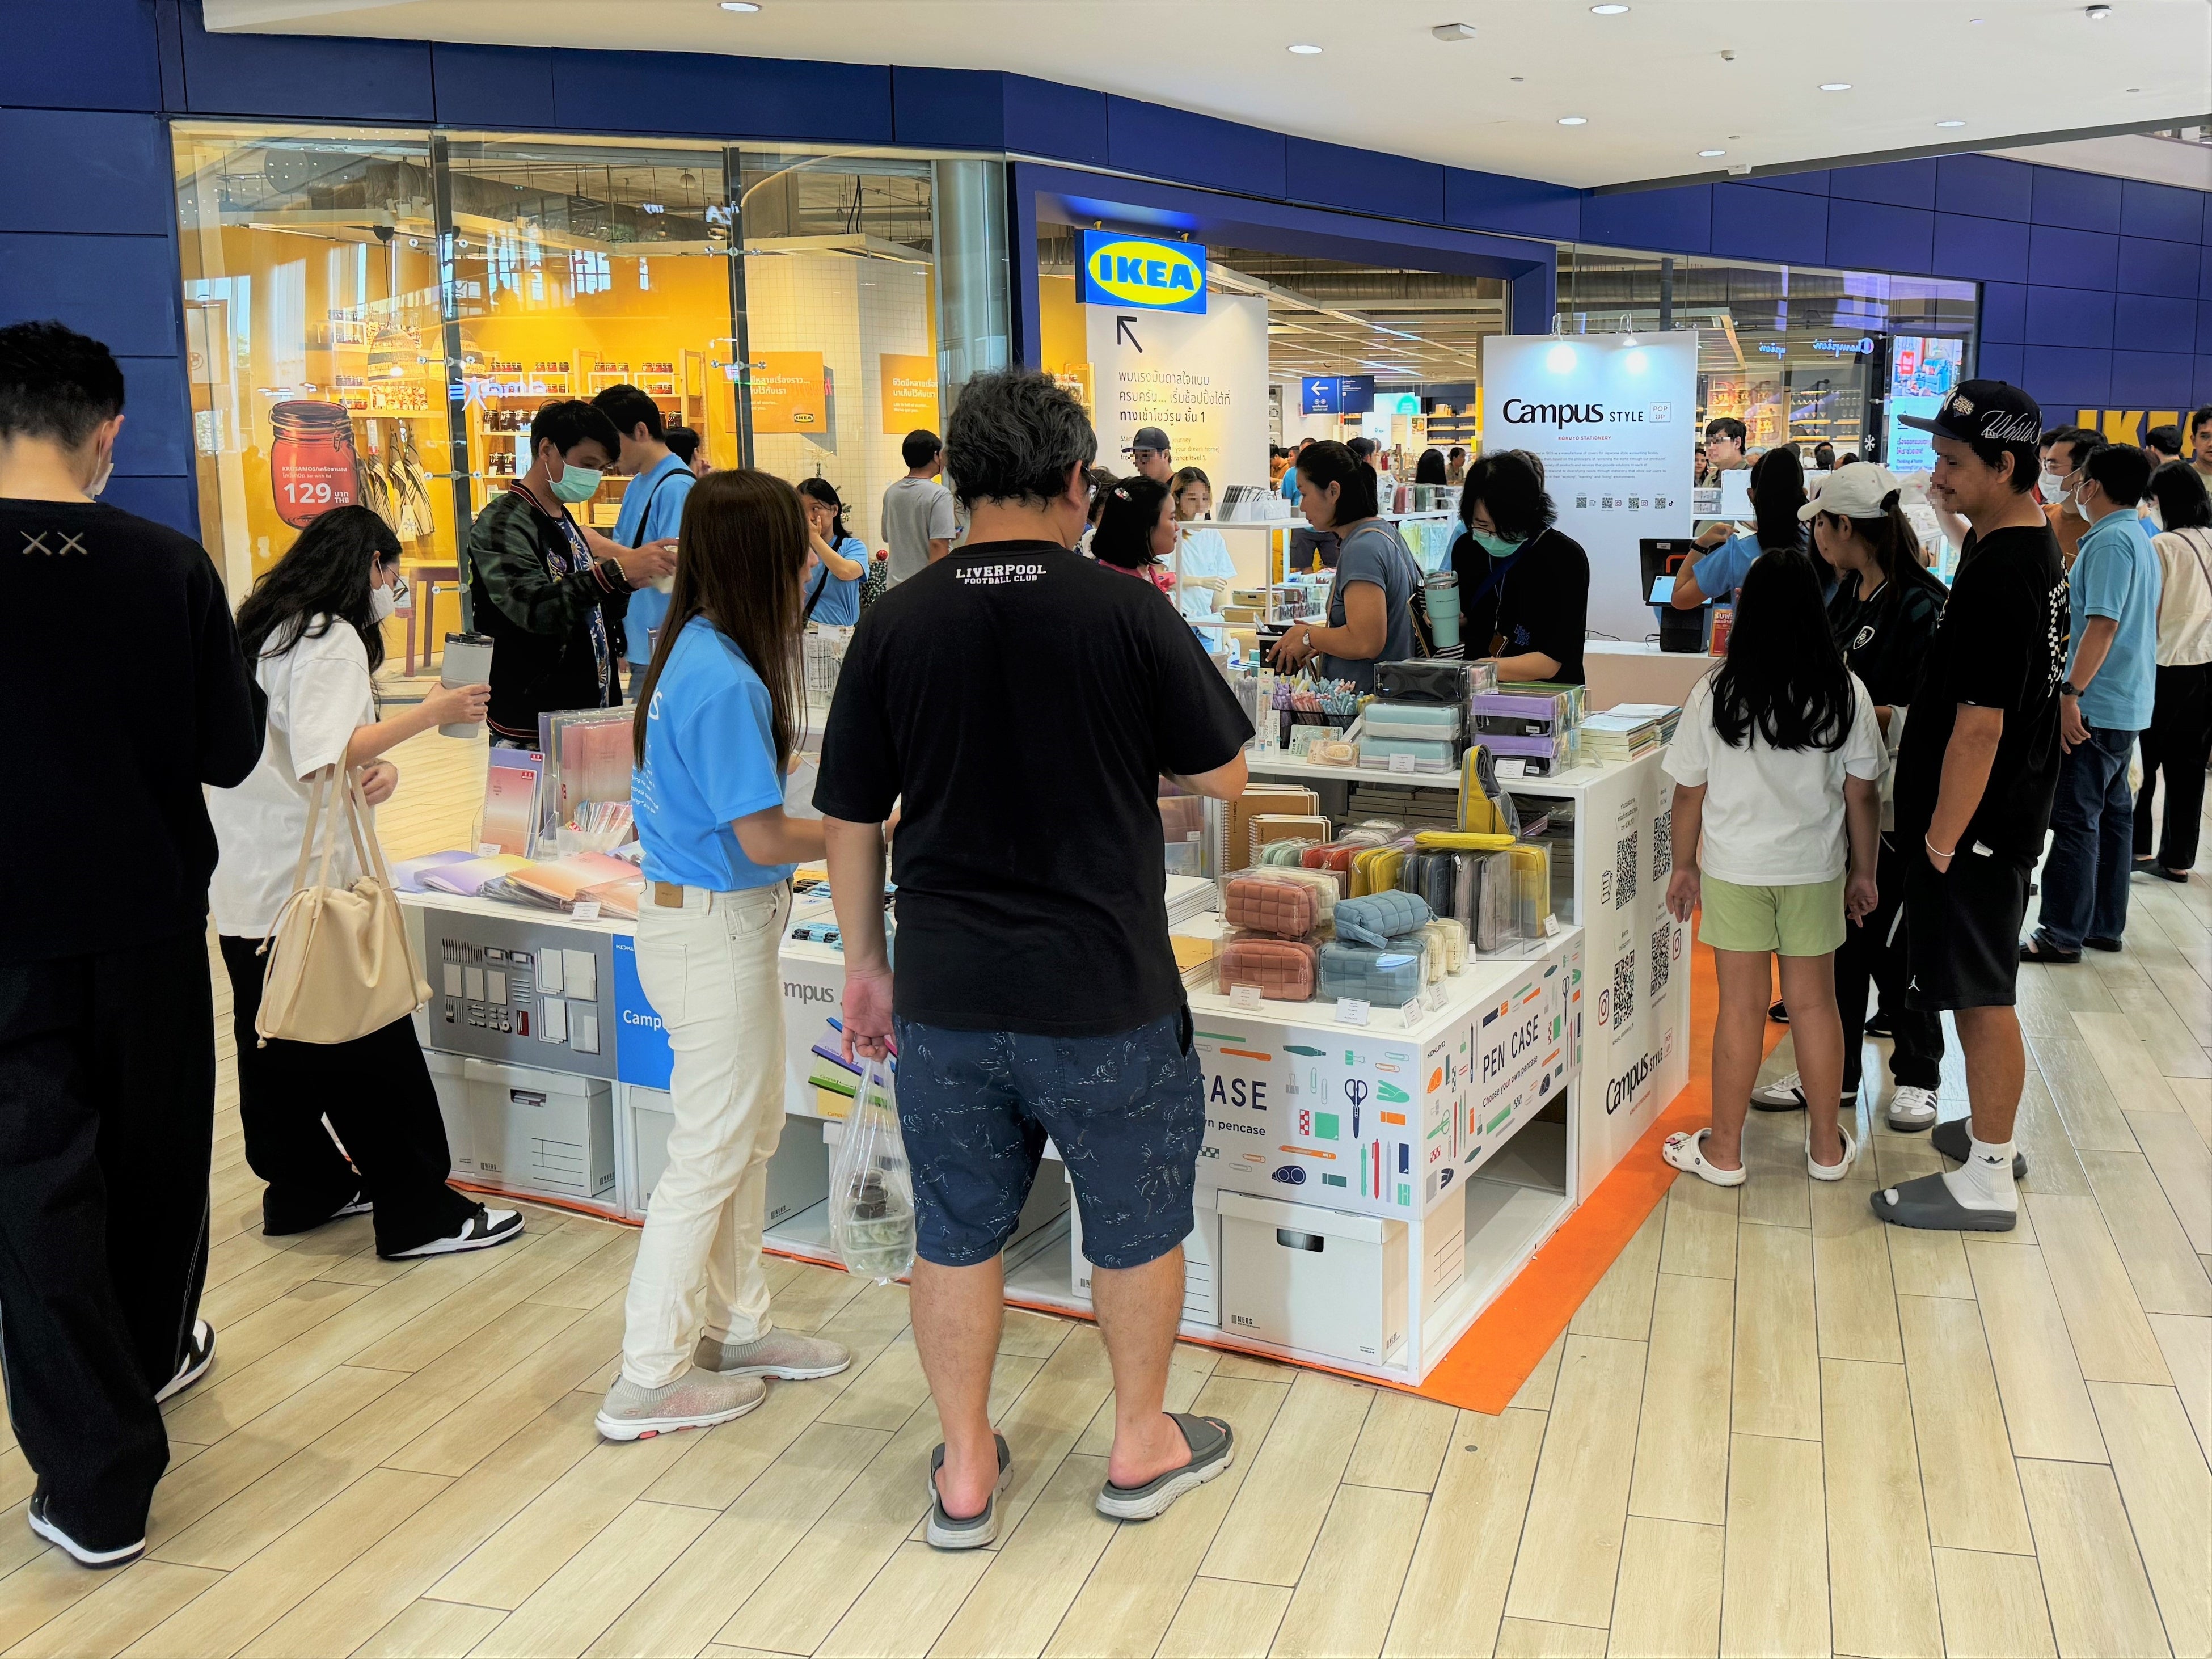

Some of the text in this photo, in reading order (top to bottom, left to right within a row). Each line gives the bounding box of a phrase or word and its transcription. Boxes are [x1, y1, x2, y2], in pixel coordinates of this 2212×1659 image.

[1099, 254, 1195, 290] IKEA
[1119, 370, 1209, 385] พบแรงบันดาลใจแบบ
[1120, 407, 1205, 425] ทางเข้าโชว์รูม ชั้น 1
[1503, 399, 1643, 429] Campus STYLE
[284, 483, 331, 503] 129
[956, 565, 1046, 579] LIVERPOOL
[964, 576, 1011, 584] FOOTBALL
[784, 982, 834, 1004] mpus
[623, 1010, 662, 1031] Camp
[1427, 1041, 1446, 1058] KOKUYO
[1483, 1014, 1539, 1083] PEN CASE
[1483, 1056, 1538, 1107] Choose your own pencase
[1606, 1053, 1648, 1115] Campus
[1649, 1048, 1662, 1072] STYLE
[1210, 1075, 1267, 1111] ASE
[1218, 1120, 1265, 1136] pencase
[1238, 1315, 1253, 1325] NEOS
